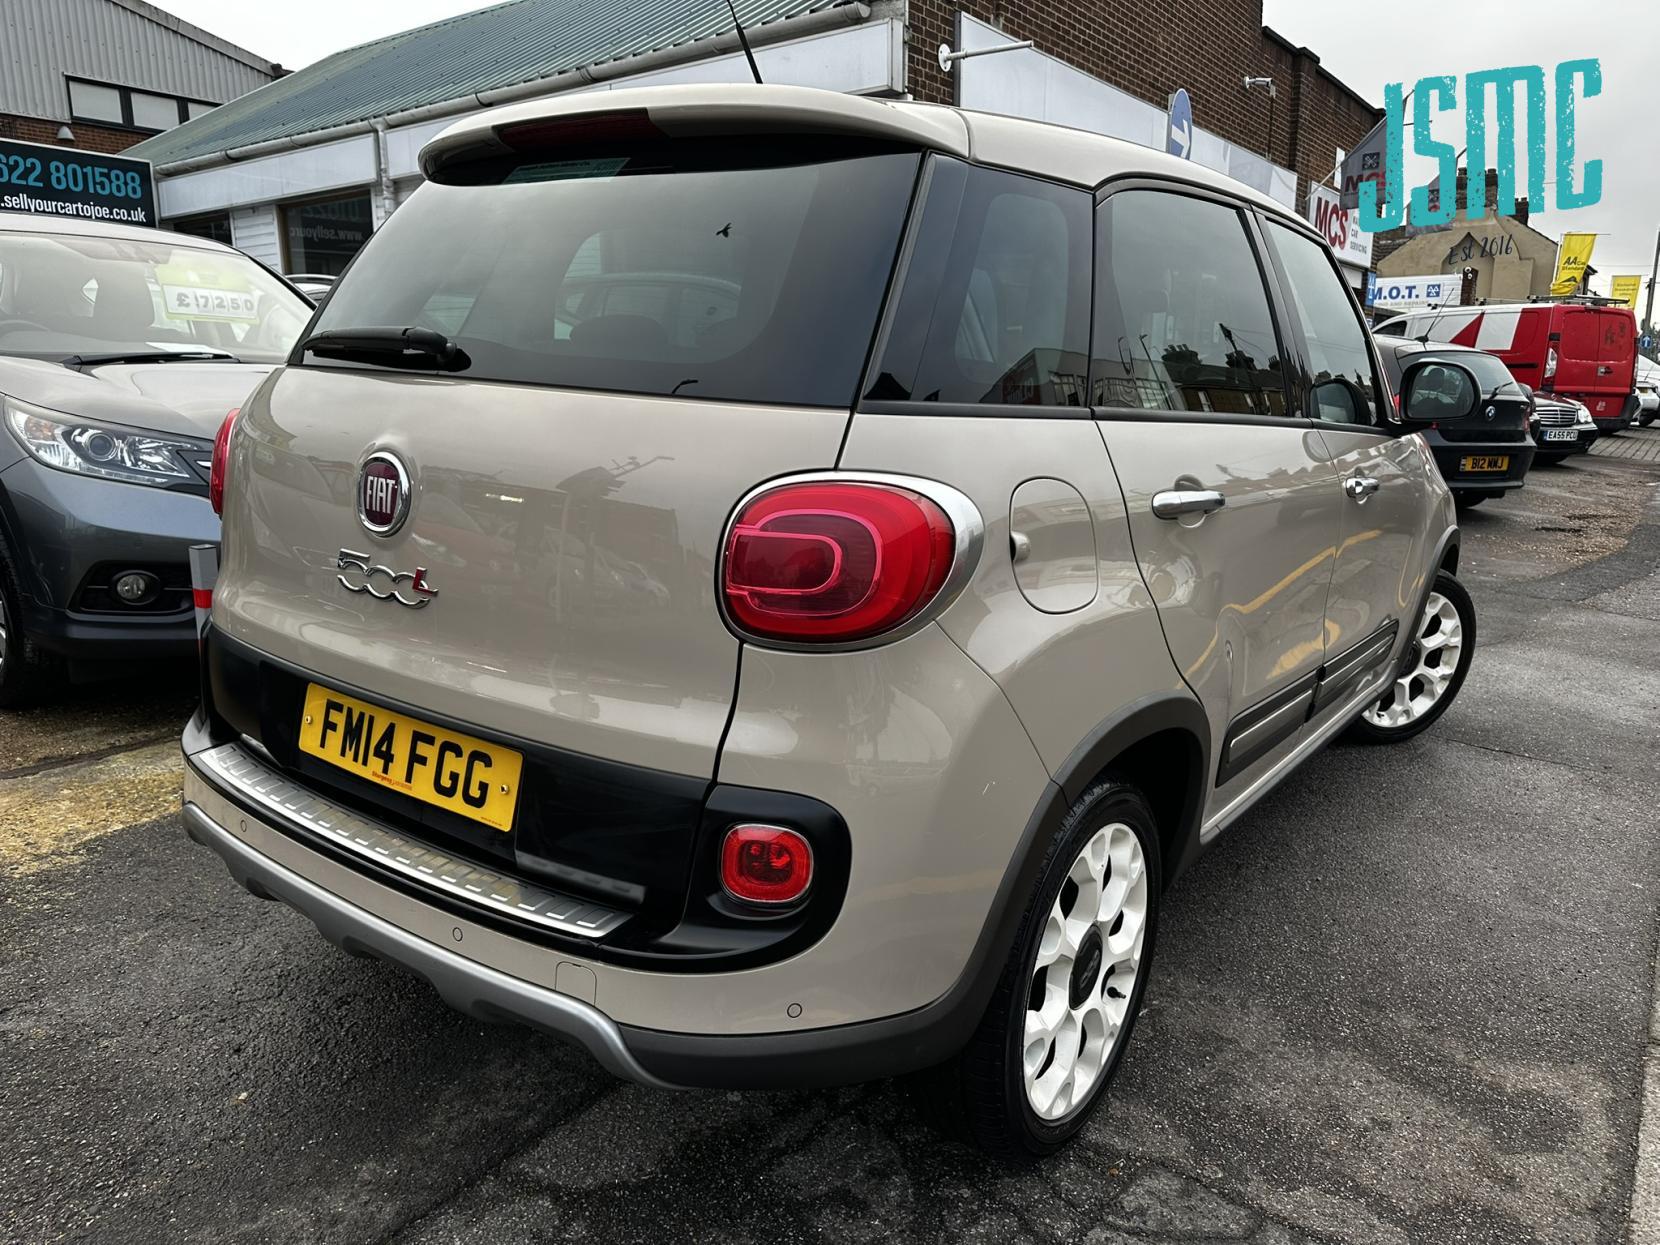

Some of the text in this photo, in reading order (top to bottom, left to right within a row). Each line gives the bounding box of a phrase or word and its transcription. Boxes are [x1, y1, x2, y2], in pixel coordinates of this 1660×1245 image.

[49, 160, 142, 199] 801588
[1315, 196, 1348, 250] MCS
[365, 475, 396, 514] FIAT
[319, 698, 493, 809] FM14 FGG
